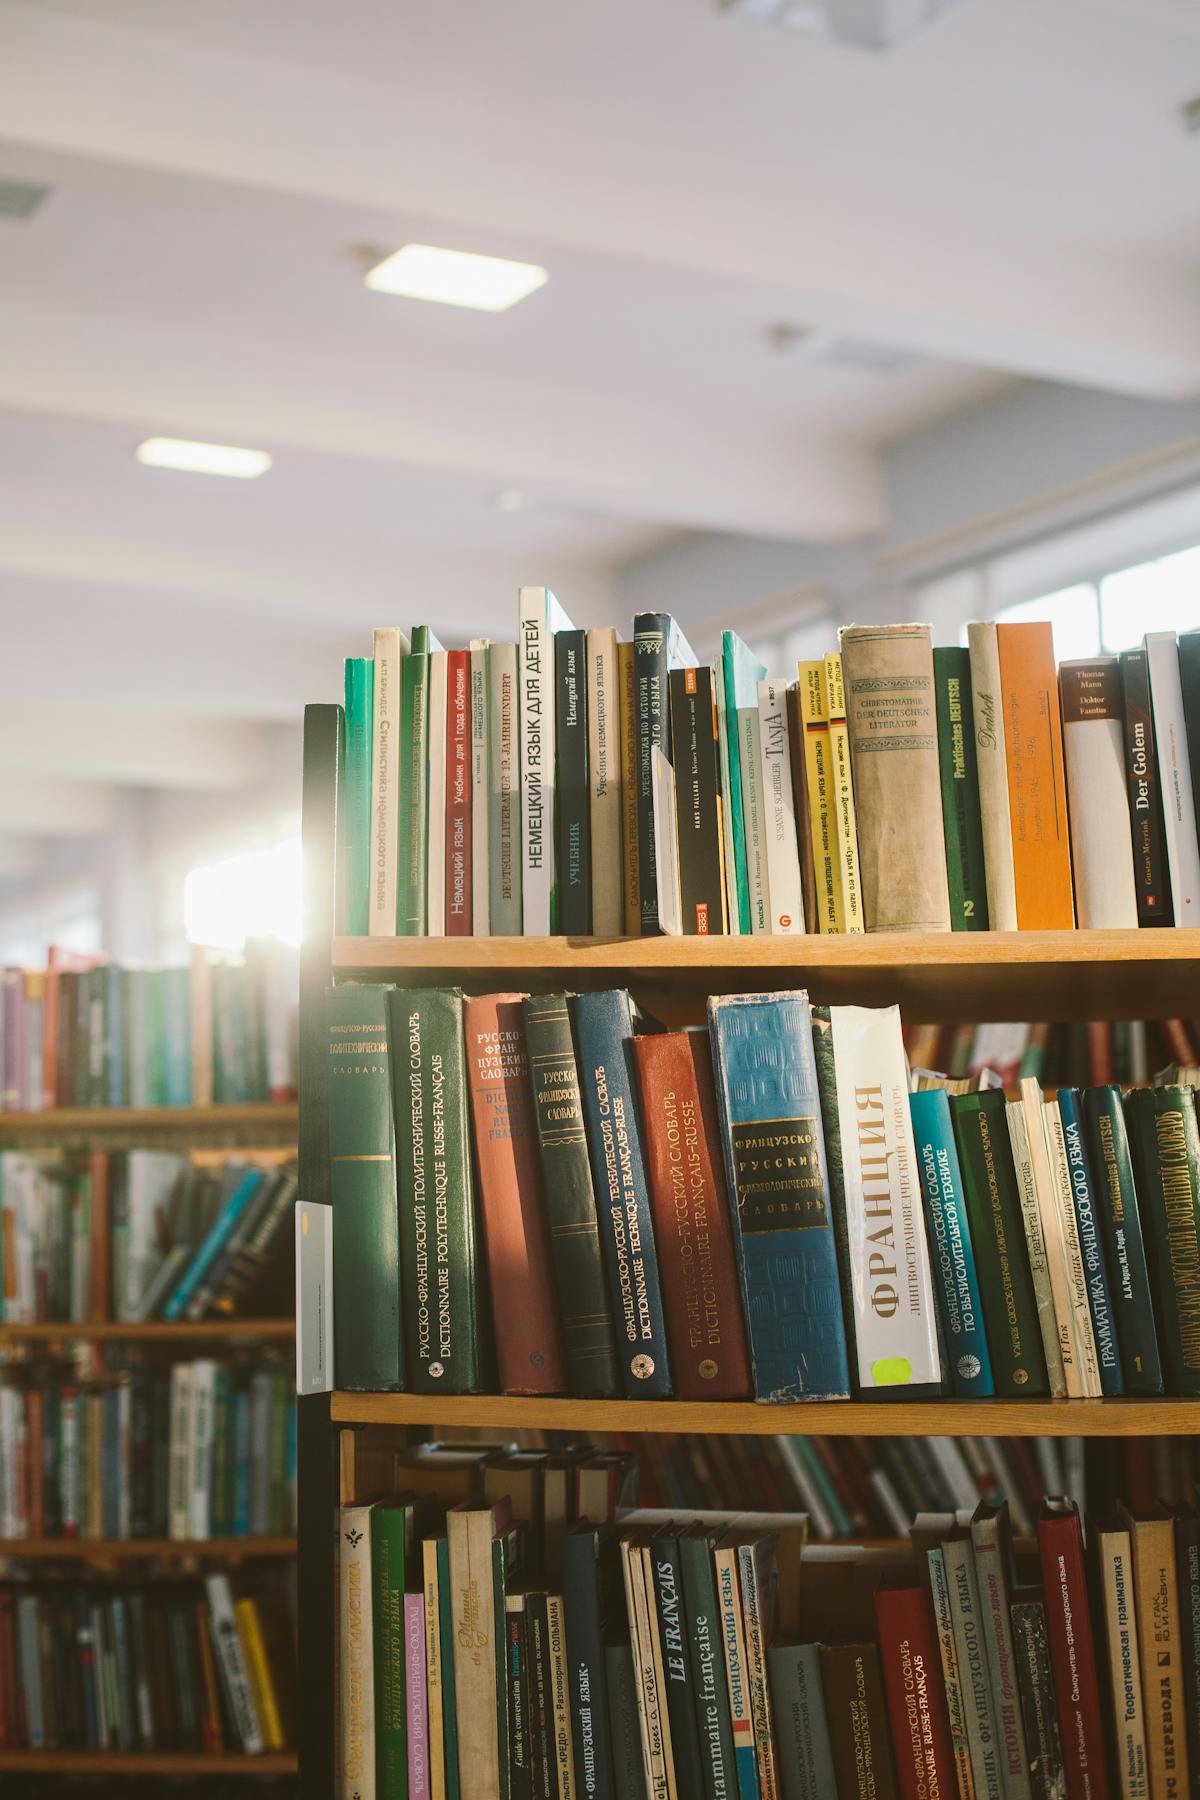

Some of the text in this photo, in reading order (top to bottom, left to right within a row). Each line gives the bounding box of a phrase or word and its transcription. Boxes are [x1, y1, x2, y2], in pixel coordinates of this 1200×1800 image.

[453, 669, 465, 711] обучения
[565, 649, 579, 727] Немецкий язык
[651, 676, 661, 716] ЯЗЫКА
[947, 678, 961, 722] DEUTSCH
[1076, 671, 1105, 679] Thomas
[455, 713, 465, 735] года
[501, 673, 512, 755] JAHRHUNDERT
[521, 619, 544, 869] НЕМЕЦКИЙ ЯЗЫК ДЛЯ ДЕТЕЙ
[593, 655, 608, 798] Учебник немецкого языка
[639, 677, 651, 797] ХРЕСТОМАТИЯ ПО ИСТОРИИ
[763, 712, 786, 759] TANJA
[977, 691, 997, 750] Deutsch
[455, 744, 465, 760] для
[953, 724, 966, 779] Praktisches
[1132, 722, 1147, 776] Golem
[453, 765, 465, 804] Учебник
[501, 775, 512, 839] LITERATUR
[692, 780, 700, 809] FALLADA
[1134, 779, 1150, 811] Der
[453, 818, 463, 848] язык
[569, 823, 582, 885] УЧЕБНИК
[774, 806, 785, 841] SUSANNE
[1140, 819, 1152, 855] Meyrink
[450, 852, 465, 915] Немецкий
[501, 842, 512, 900] DEUTSCHE
[1142, 856, 1152, 886] Gustav
[756, 900, 765, 930] Deutsch
[963, 900, 975, 917] 2
[485, 1044, 517, 1055] ФРАН-
[663, 1092, 682, 1163] СЛОВАРЬ
[1155, 1111, 1187, 1163] СЛОВАРЬ
[408, 1012, 431, 1359] РУССКО-ФРАНЦУЗСКИЙ ПОЛИТЕХНИЧЕСКИЙ СЛОВАРЬ
[891, 1084, 921, 1317] ЛИНГВОСТРАНОВЕДЧЕСКИЙ СЛОВАРЬ
[1098, 1115, 1125, 1223] Praktisches DEUTSCH
[1158, 1165, 1196, 1229] ВОЕННЫЙ
[431, 1056, 451, 1358] DICTIONNAIRE POLYTECHNIQUE RUSSE-FRANÇAIS
[595, 1066, 638, 1344] ФРАНЦУЗСКО-РУССКИЙ ТЕХНИЧЕСКИЙ СЛОВАРЬ
[613, 1097, 653, 1341] DICTIONNAIRE TECHNIQUE FRANÇAIS-RUSSE
[680, 1100, 721, 1345] DICTIONNAIRE FRANÇAIS-RUSSE
[742, 1199, 824, 1216] СЛОВАРЬ
[853, 1085, 899, 1319] ФРАНЦИЯ
[1020, 1161, 1045, 1273] Je parlerai français
[921, 1144, 962, 1335] ФРАНЦУЗСКО-РУССКИЙ СЛОВАРЬ
[936, 1149, 976, 1333] ПО ВЫЧИСЛИТЕЛЬНОЙ ТЕХНИКЕ
[978, 1111, 1021, 1359] СЛОВАРЬ РАЗГОВОРНОЙ ЛЕКСИКИ ФРАНЦУЗСКОГО ЯЗЫКА
[1065, 1121, 1116, 1368] ГРАММАТИКА ФРАНЦУЗСКОГО ЯЗЫКА
[1070, 1254, 1090, 1311] Учебник
[1059, 1324, 1071, 1344] Гак
[389, 1588, 401, 1631] ЯЗЫКА
[656, 1560, 686, 1683] LE FRANÇAIS
[1056, 1556, 1081, 1703] Самоучитель французского языка
[1112, 1556, 1136, 1723] Теоретическая грамматика
[693, 1615, 717, 1702] française
[720, 1567, 744, 1719] ФРАНЦУЗСКИЙ ЯЗЫК
[899, 1639, 914, 1692] СЛОВАРЬ
[954, 1562, 992, 1744] ФРАНЦУЗСКОГО ЯЗЫКА
[1022, 1617, 1040, 1685] РАЗГОВОРНИК
[409, 1606, 426, 1794] РУССКО-ФРАНЦУЗСКИЙ СЛОВАРЬ
[513, 1680, 522, 1730] conversation
[548, 1601, 569, 1769] «КРЕДО» Разговорник СОЛЬМАНА
[854, 1656, 866, 1699] СЛОВАРЬ
[913, 1654, 934, 1745] RUSSE-FRANÇAIS
[514, 1730, 522, 1740] de
[514, 1741, 524, 1765] Guide
[578, 1668, 597, 1793] ФРАНЦУЗСКИЙ ЯЗЫК
[1002, 1704, 1023, 1777] ИСТОРИЯ
[1159, 1676, 1176, 1772] ПЕРЕВОДА
